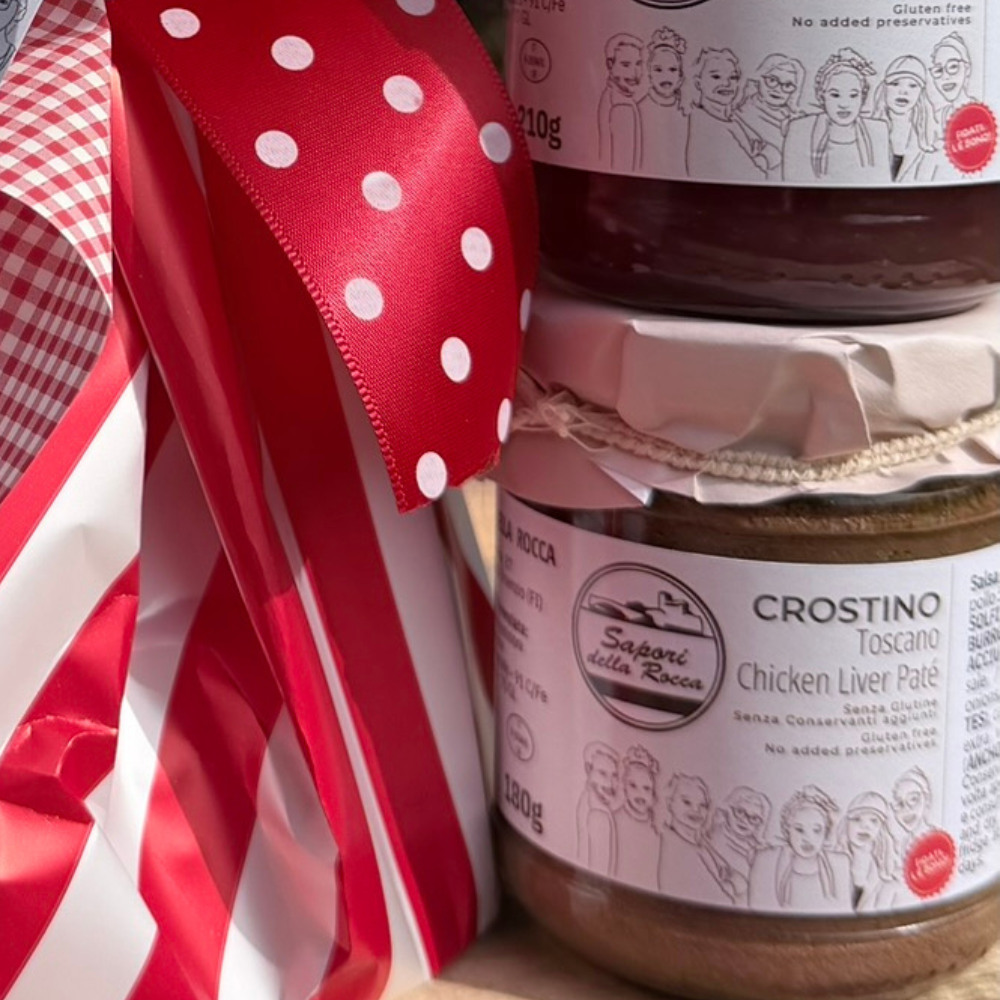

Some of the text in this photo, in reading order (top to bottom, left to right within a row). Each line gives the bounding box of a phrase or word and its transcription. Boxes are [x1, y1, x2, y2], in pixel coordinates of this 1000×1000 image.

[791, 15, 972, 30] No added preservatives
[893, 3, 972, 15] Gluten free
[518, 104, 562, 150] 210g
[517, 526, 557, 568] ROCCA
[753, 591, 941, 624] CROSTINO
[601, 626, 689, 666] Sapori
[856, 627, 940, 656] Toscano
[587, 649, 704, 690] della Rocca
[737, 658, 940, 695] Chicken Liver Paté
[733, 709, 780, 724] Senza
[786, 713, 877, 727] Conservanti
[843, 703, 886, 715] Senza
[764, 743, 785, 754] No
[792, 745, 840, 756] added
[861, 731, 908, 743] Gluten
[504, 773, 544, 835] 180g
